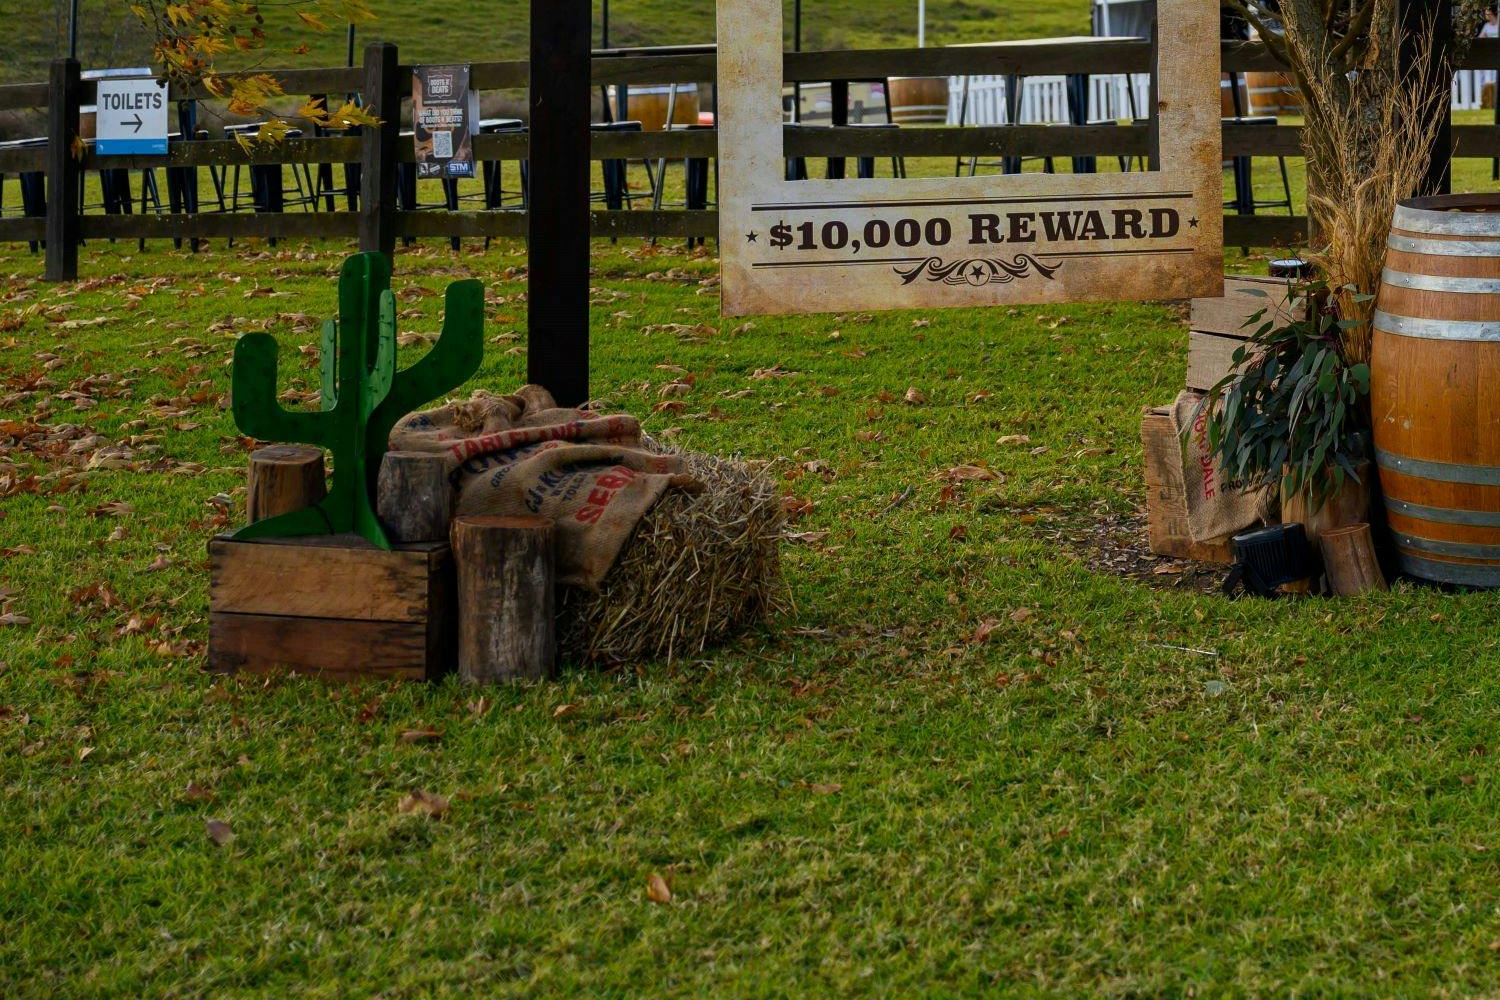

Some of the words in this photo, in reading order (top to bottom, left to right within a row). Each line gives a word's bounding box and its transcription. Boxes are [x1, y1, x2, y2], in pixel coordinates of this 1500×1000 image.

[102, 92, 162, 110] TOILETS
[450, 163, 468, 171] STM
[769, 216, 952, 254] $10,000
[968, 208, 1180, 244] REWARD
